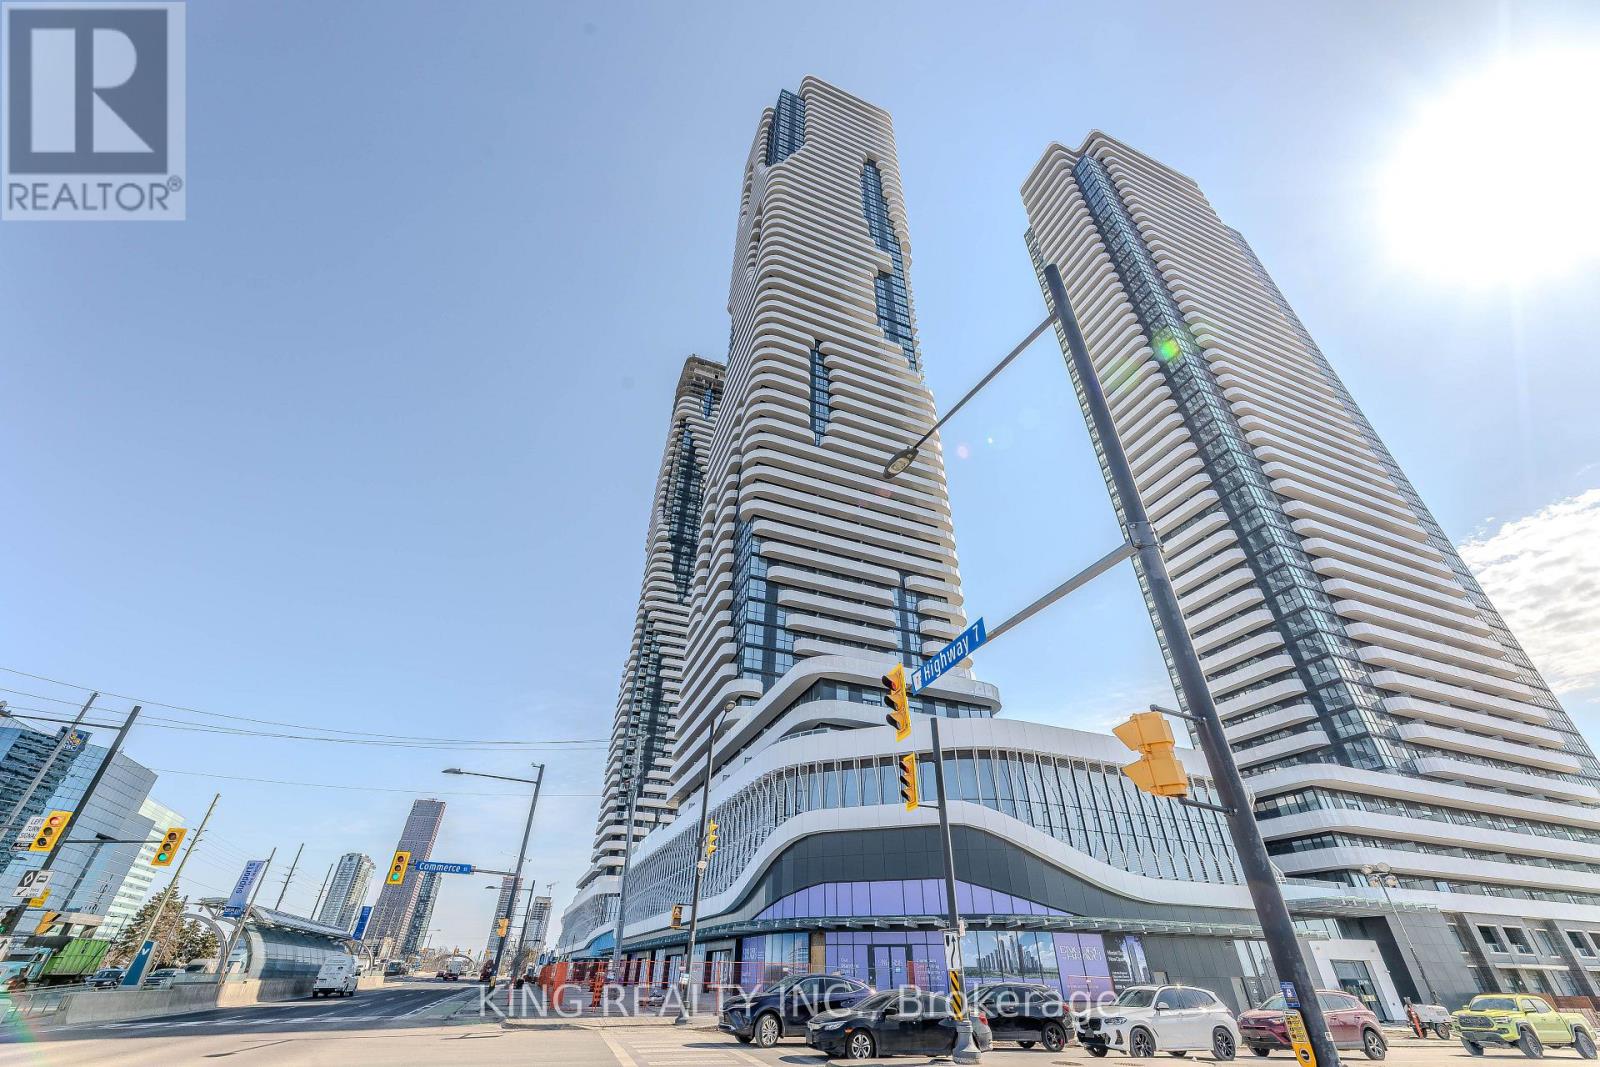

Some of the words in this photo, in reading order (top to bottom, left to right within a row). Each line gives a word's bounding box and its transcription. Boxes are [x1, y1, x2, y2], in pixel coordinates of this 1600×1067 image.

[923, 635, 969, 681] Highway
[972, 624, 979, 641] 7
[235, 862, 256, 894] supports
[419, 862, 461, 872] Commerce
